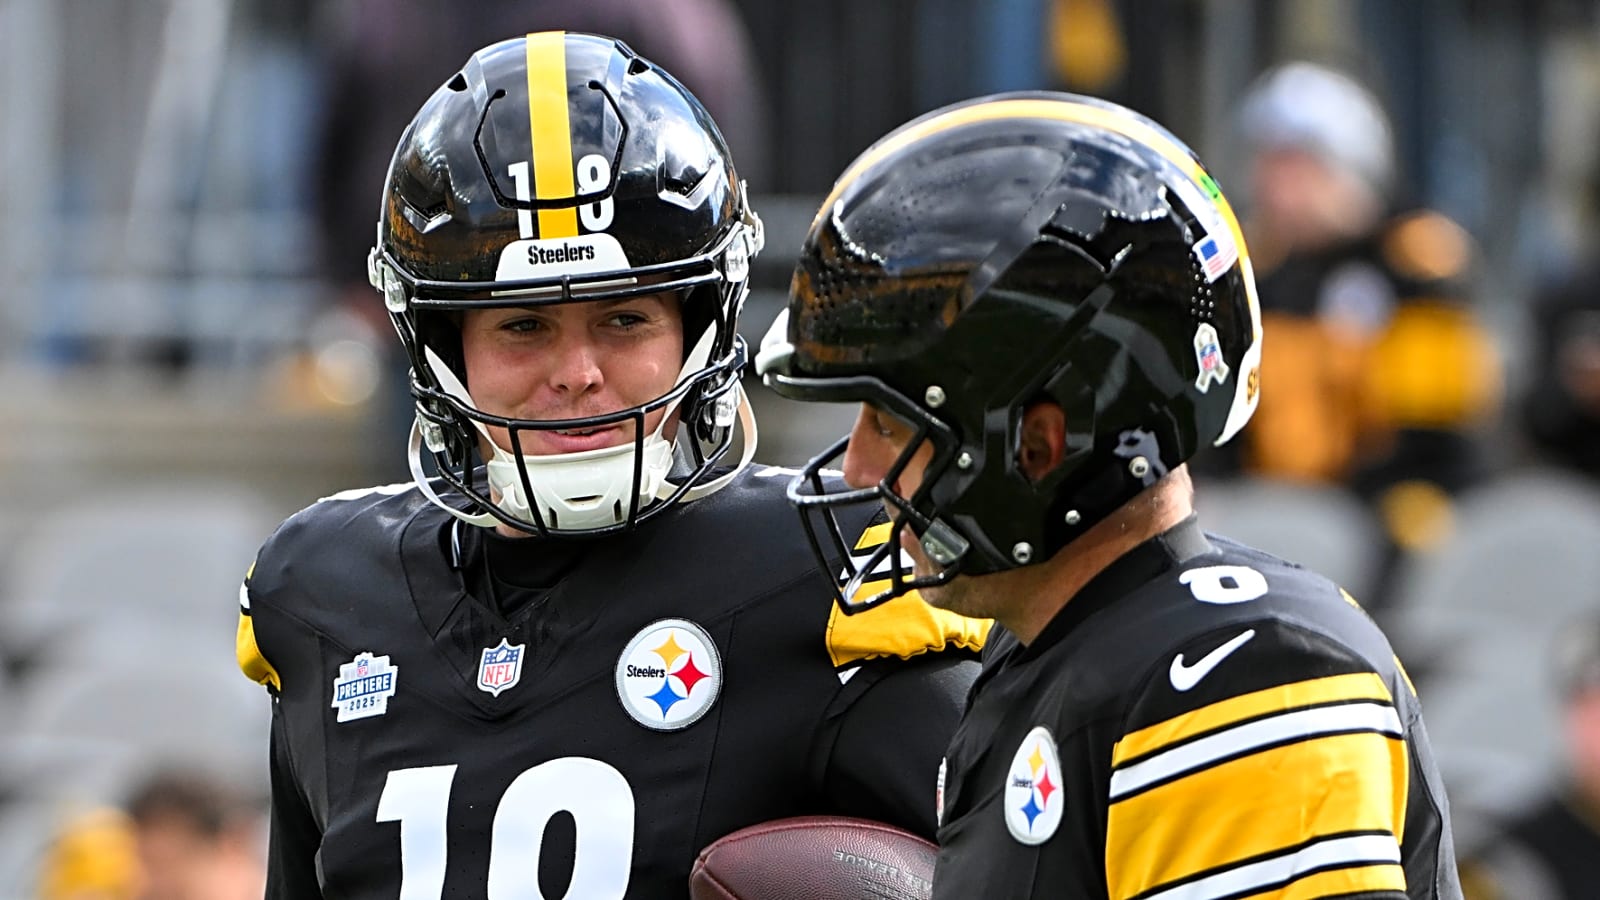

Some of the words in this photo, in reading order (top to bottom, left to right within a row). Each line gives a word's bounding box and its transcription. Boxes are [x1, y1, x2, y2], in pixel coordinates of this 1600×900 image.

[527, 242, 595, 265] Steelers
[484, 663, 512, 685] NFL
[626, 664, 666, 679] Steelers
[833, 851, 899, 877] LEAGUE
